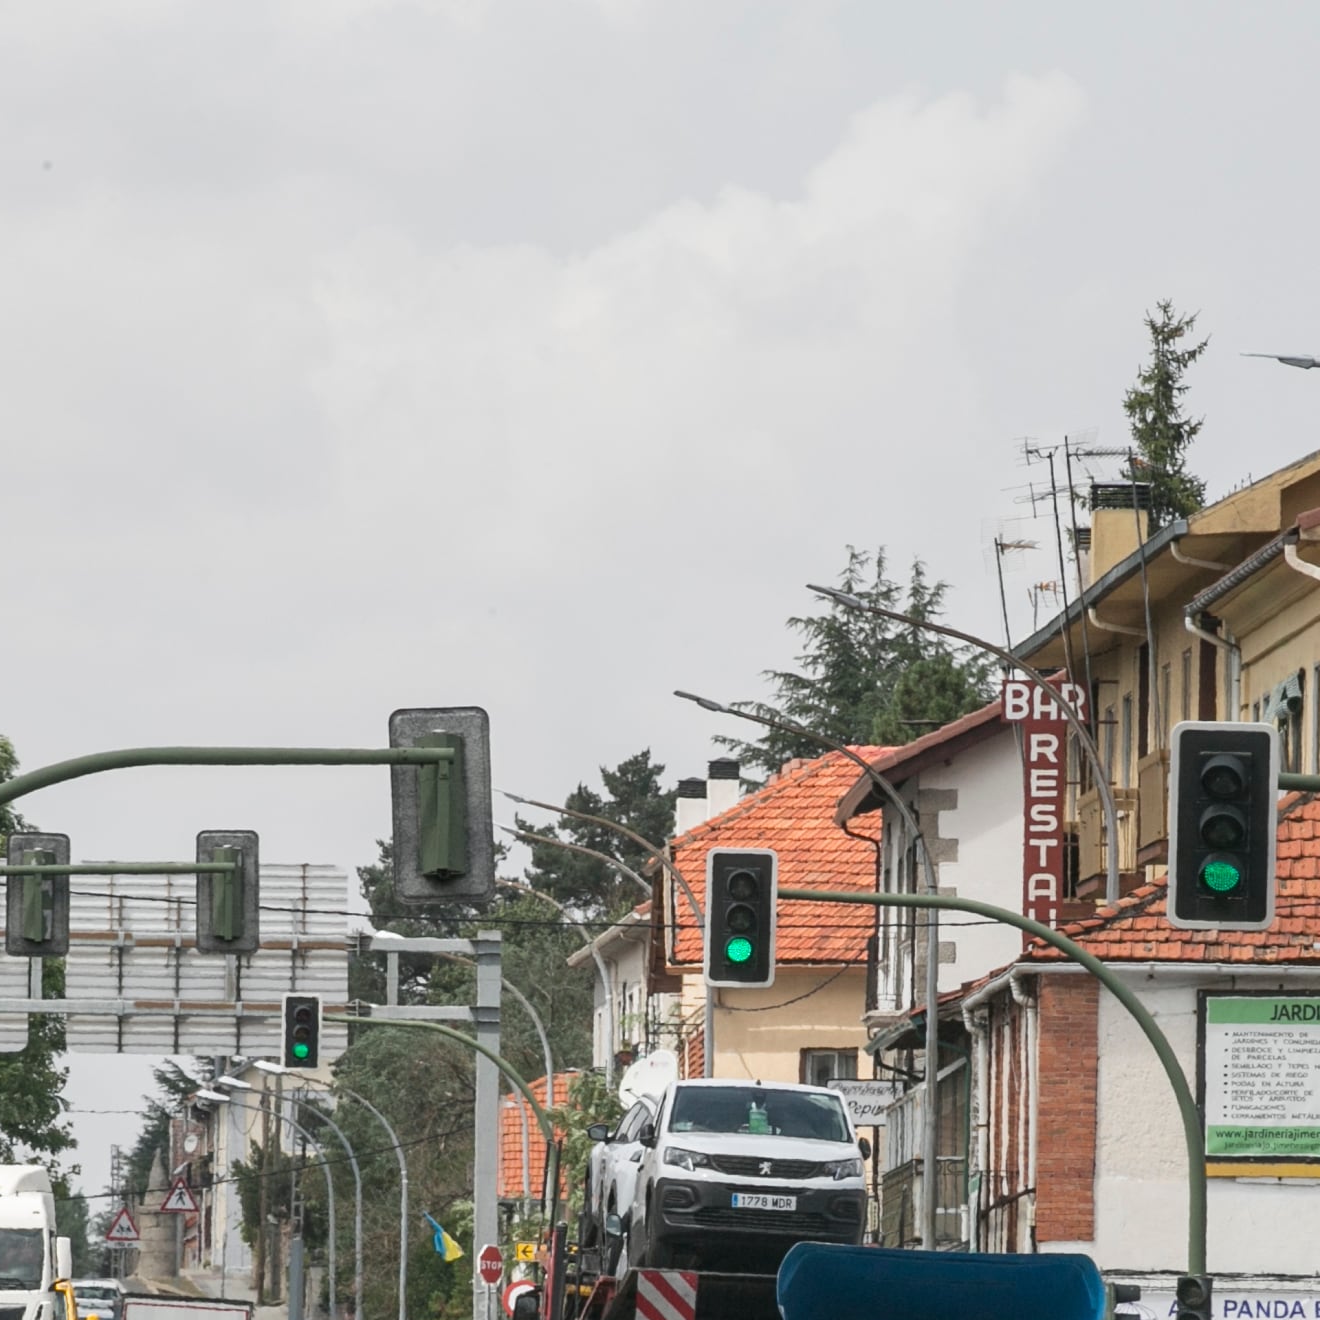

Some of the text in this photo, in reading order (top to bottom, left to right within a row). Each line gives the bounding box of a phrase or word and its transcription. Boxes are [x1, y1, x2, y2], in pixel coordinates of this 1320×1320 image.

[1004, 682, 1086, 721] BAR
[741, 1196, 793, 1209] 1778 MDR
[480, 1261, 502, 1271] STOP
[1223, 1300, 1307, 1318] PANDA
